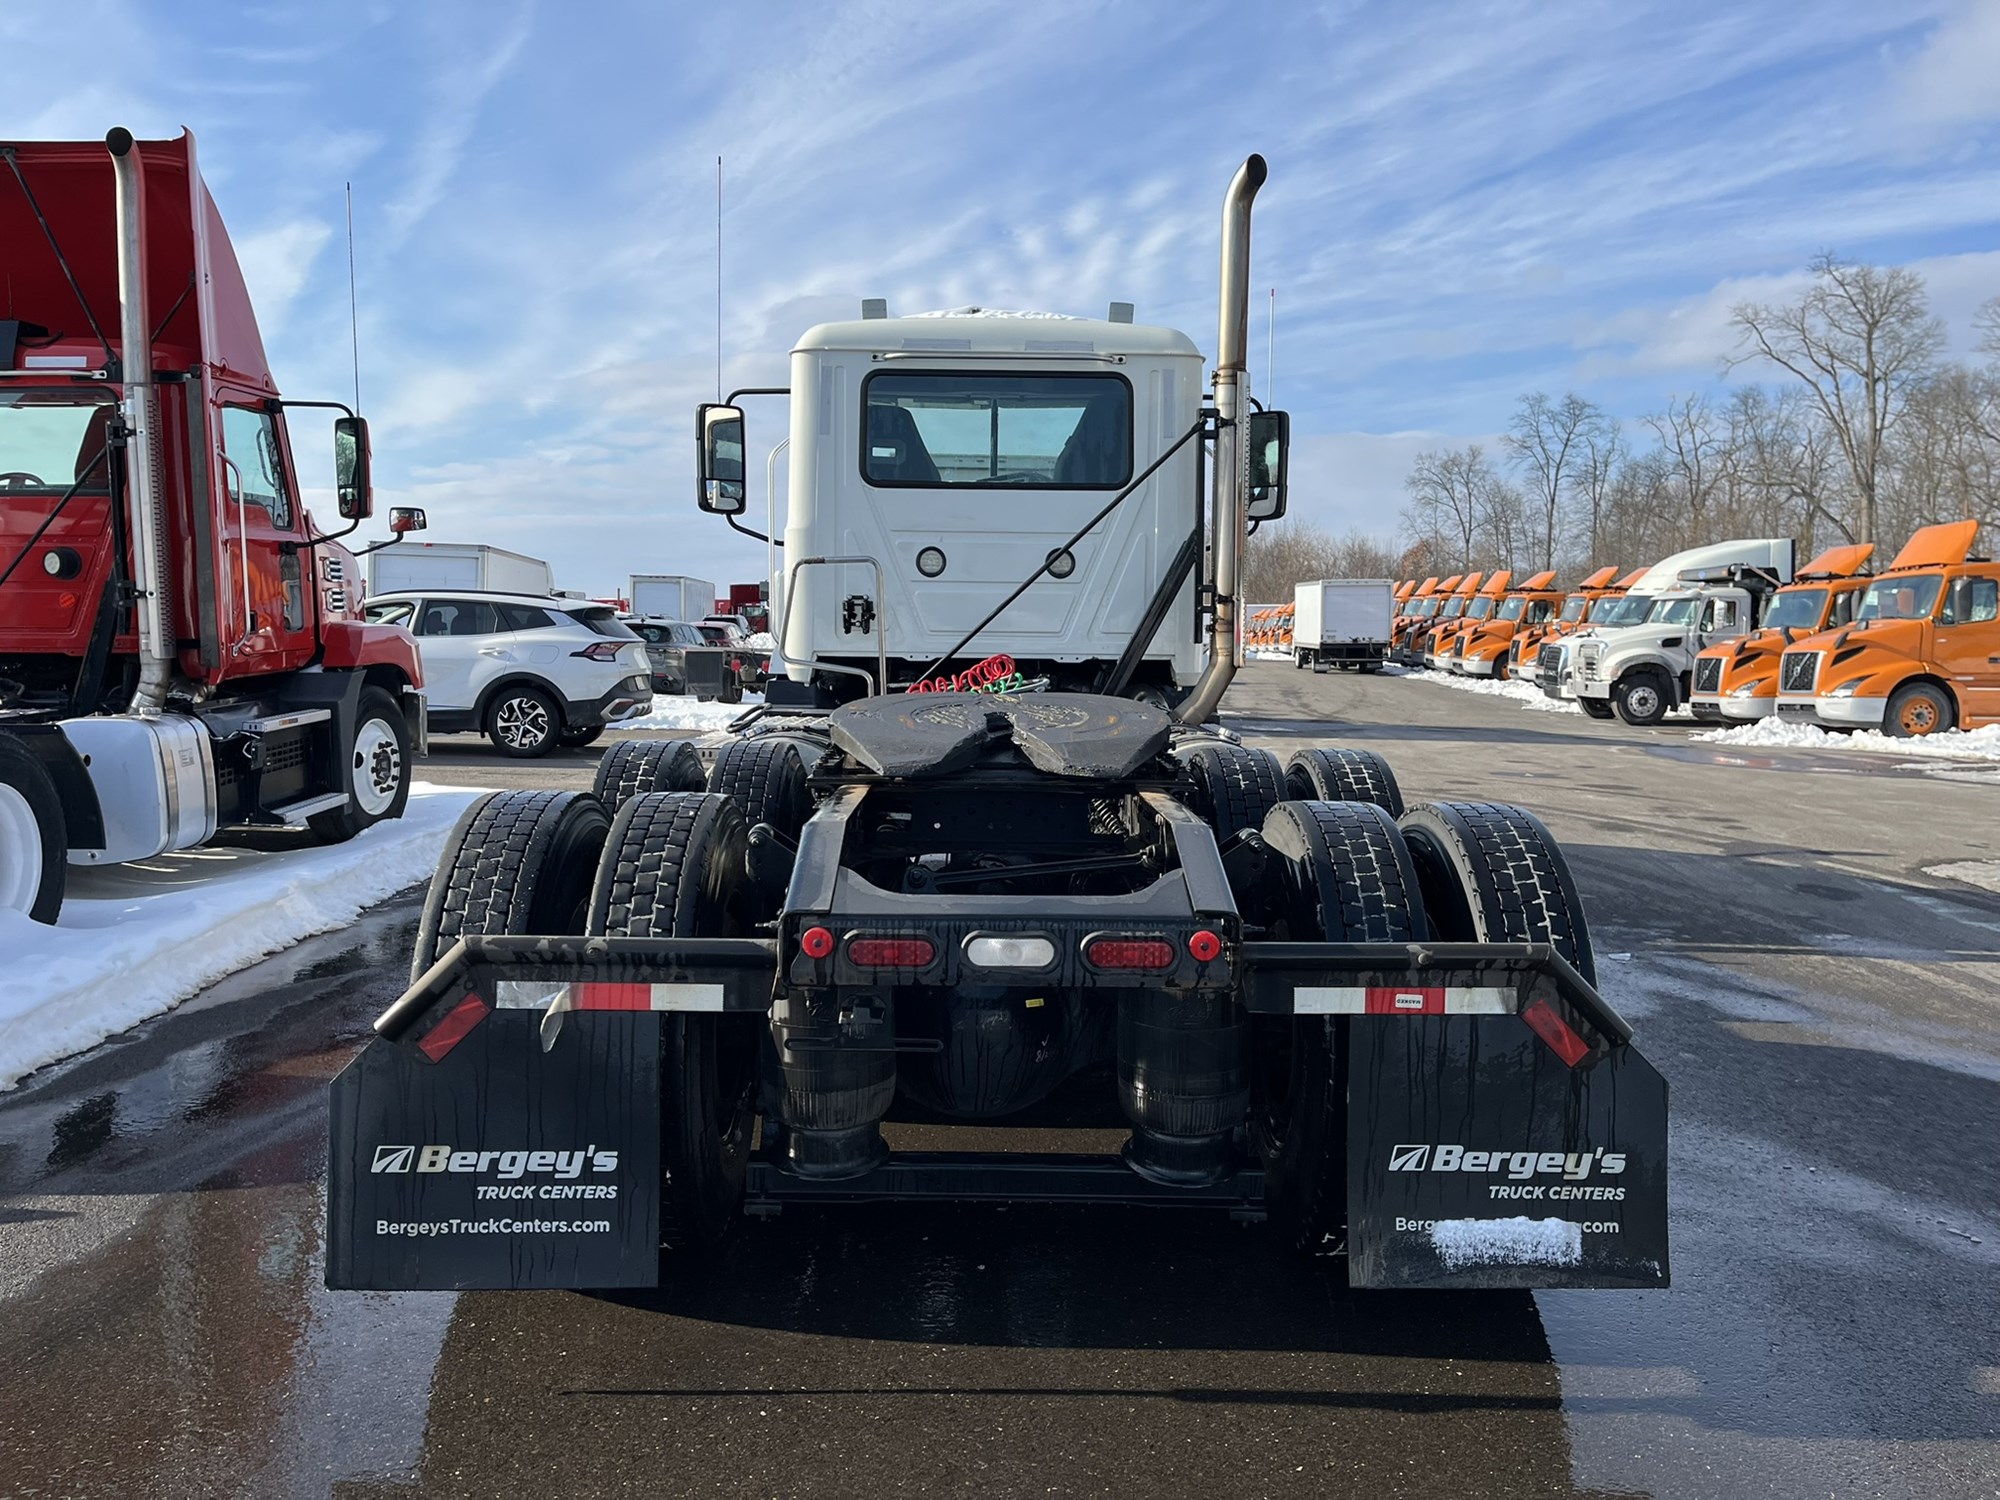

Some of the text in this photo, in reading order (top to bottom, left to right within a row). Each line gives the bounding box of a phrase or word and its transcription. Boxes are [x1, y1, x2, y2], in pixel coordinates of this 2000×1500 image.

[416, 1144, 618, 1179] Bergey's
[1431, 1144, 1626, 1180] Bergey's
[476, 1185, 618, 1200] TRUCK CENTERS
[1489, 1185, 1626, 1201] TRUCK CENTERS
[376, 1218, 610, 1237] BergeysTruckCenters.com
